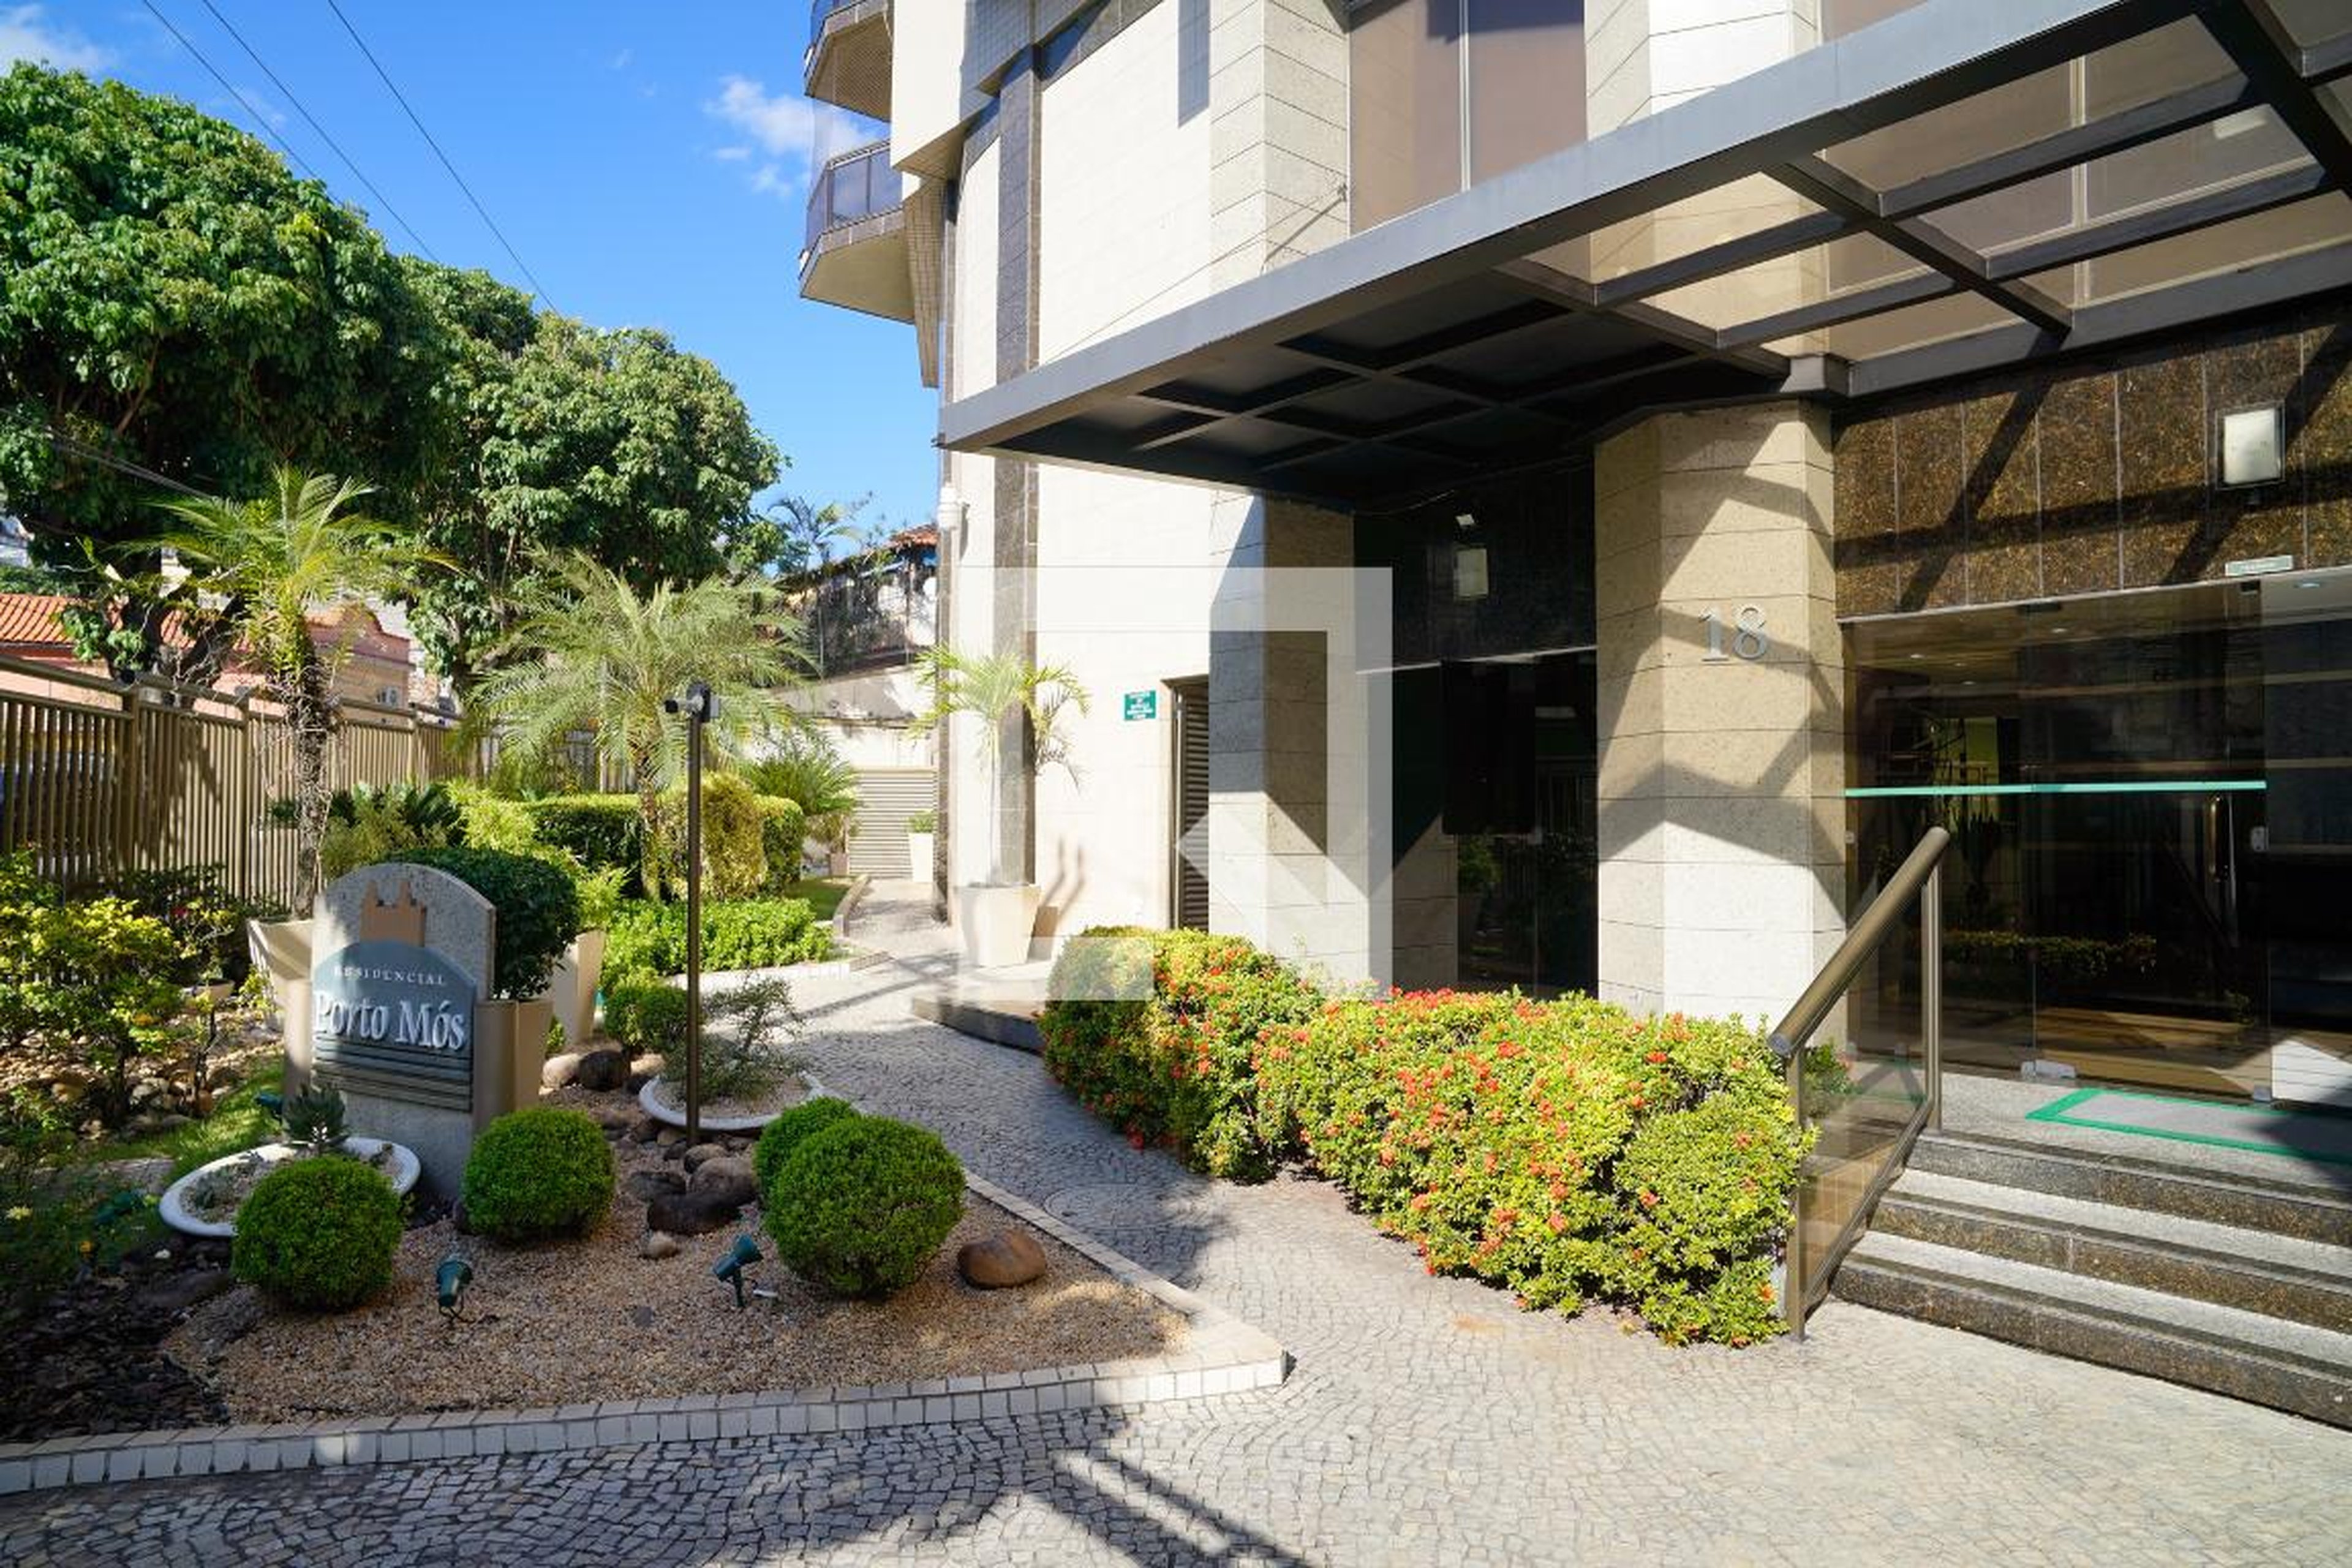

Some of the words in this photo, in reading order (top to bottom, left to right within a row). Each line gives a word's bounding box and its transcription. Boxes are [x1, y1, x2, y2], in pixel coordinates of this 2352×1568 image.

[1698, 605, 1767, 662] 18
[334, 965, 445, 985] RESIDENCIAL
[314, 990, 389, 1039] Porto
[396, 1000, 465, 1050] Mós
